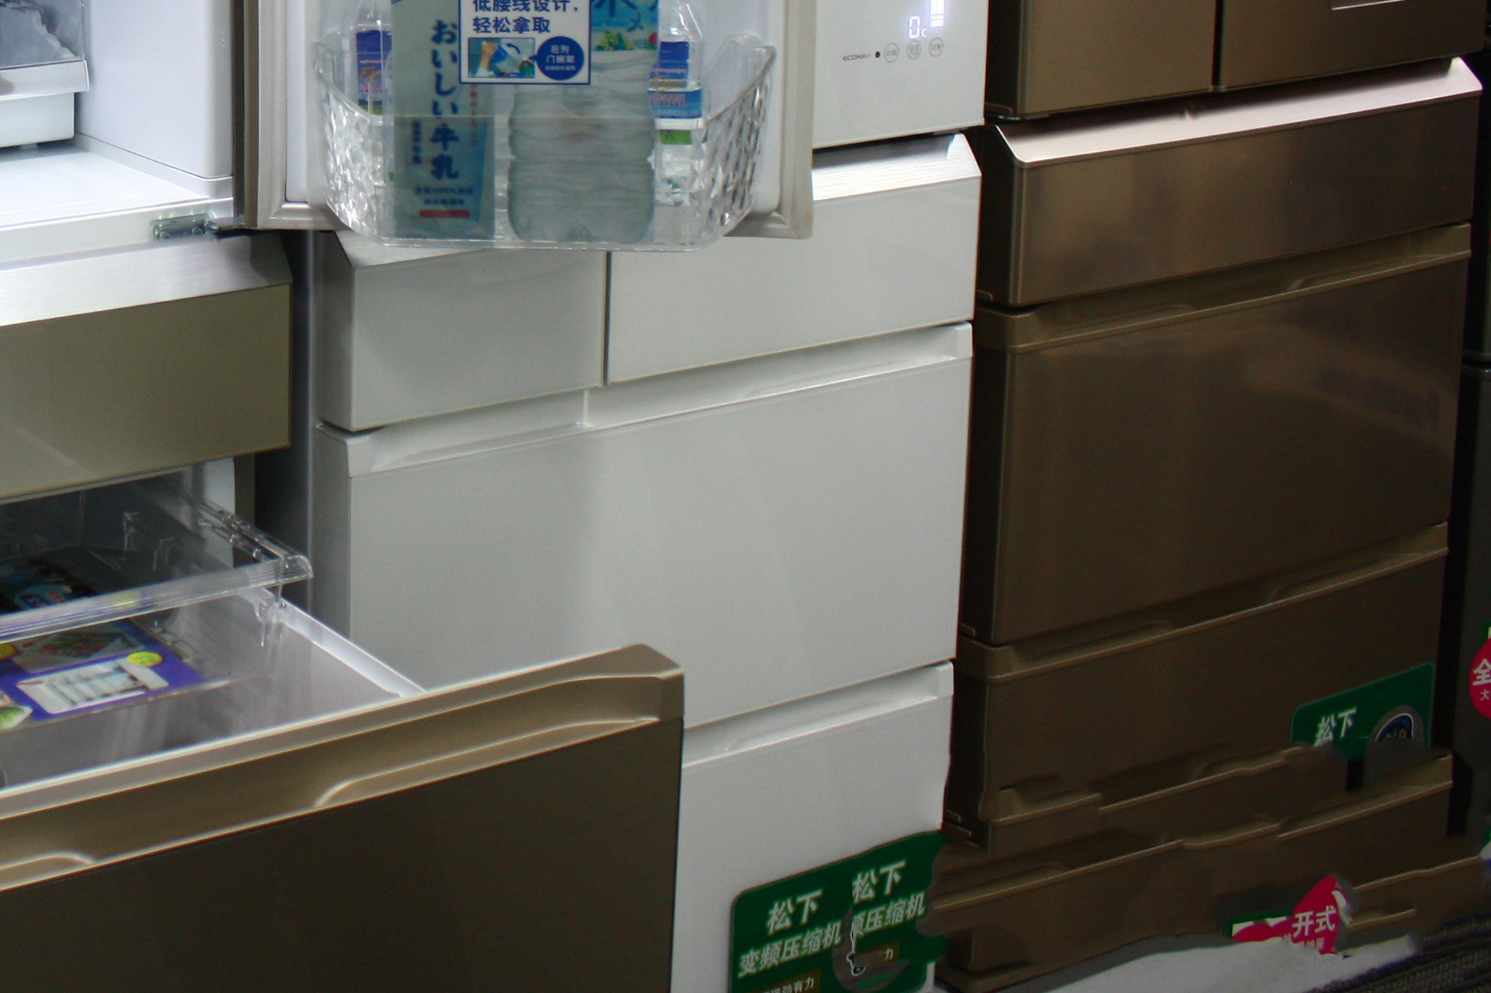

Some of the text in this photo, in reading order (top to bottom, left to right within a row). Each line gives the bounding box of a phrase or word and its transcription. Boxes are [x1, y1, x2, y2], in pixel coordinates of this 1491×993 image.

[473, 16, 551, 34] 轻松拿取
[431, 19, 459, 181] おいしい牛乳
[1313, 707, 1357, 747] 松下
[852, 860, 906, 904] 松下
[767, 888, 823, 936] 松下
[1291, 905, 1337, 938] 开式
[738, 920, 843, 979] 变频压缩机
